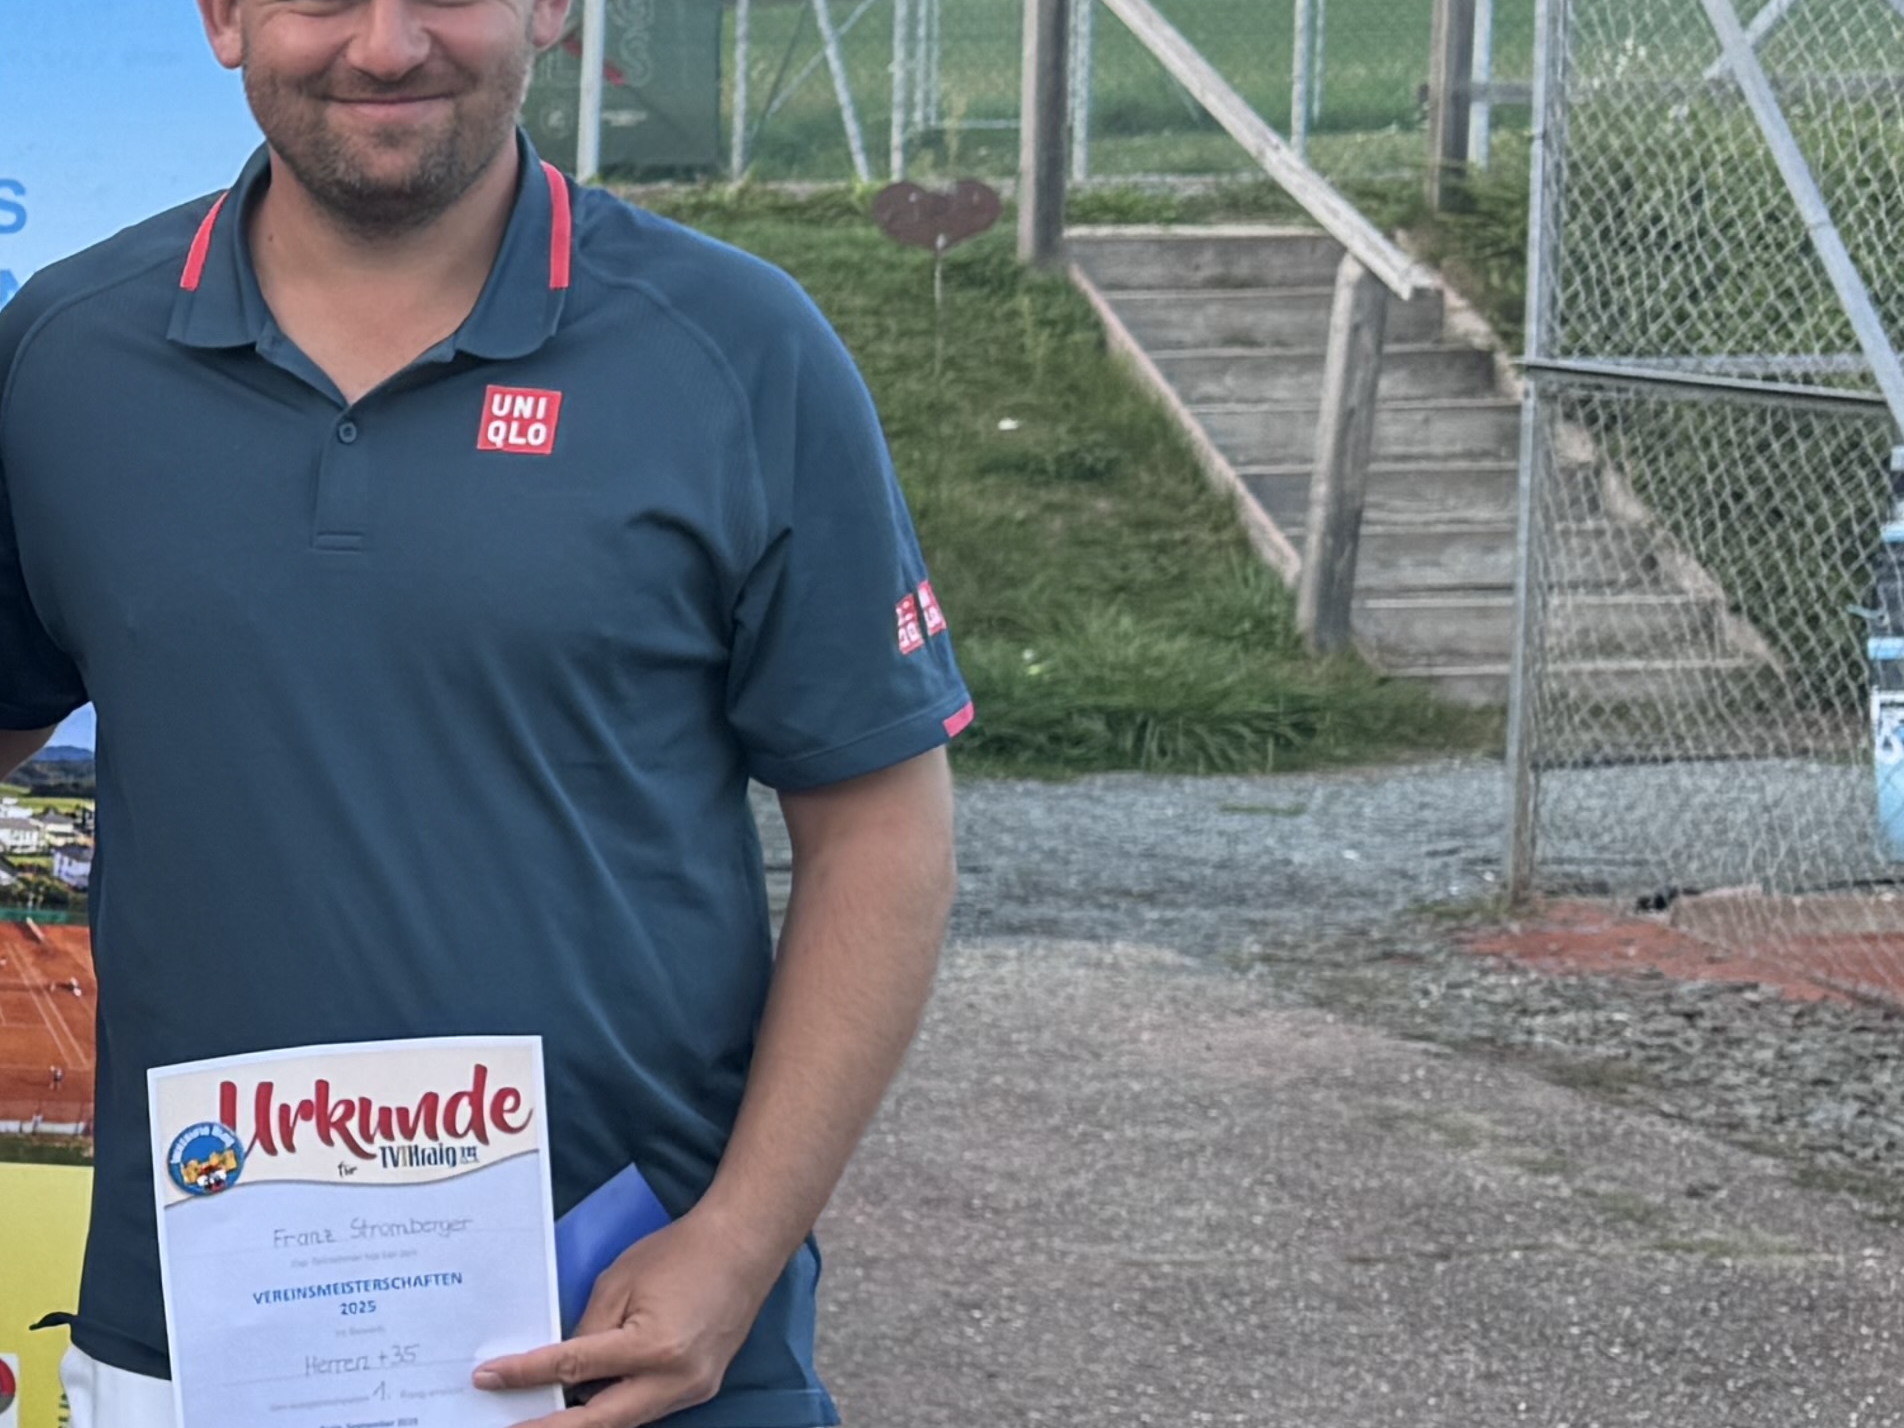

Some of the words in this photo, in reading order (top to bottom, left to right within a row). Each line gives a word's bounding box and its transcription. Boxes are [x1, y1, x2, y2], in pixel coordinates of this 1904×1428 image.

[492, 393, 547, 420] UNI
[487, 419, 547, 449] QLO
[220, 1064, 533, 1160] Urkunde
[272, 1228, 337, 1249] Franz
[253, 1272, 463, 1304] VEREINSMEISTERSCHAFTEN
[340, 1300, 377, 1315] 2025
[305, 1354, 371, 1376] Herren
